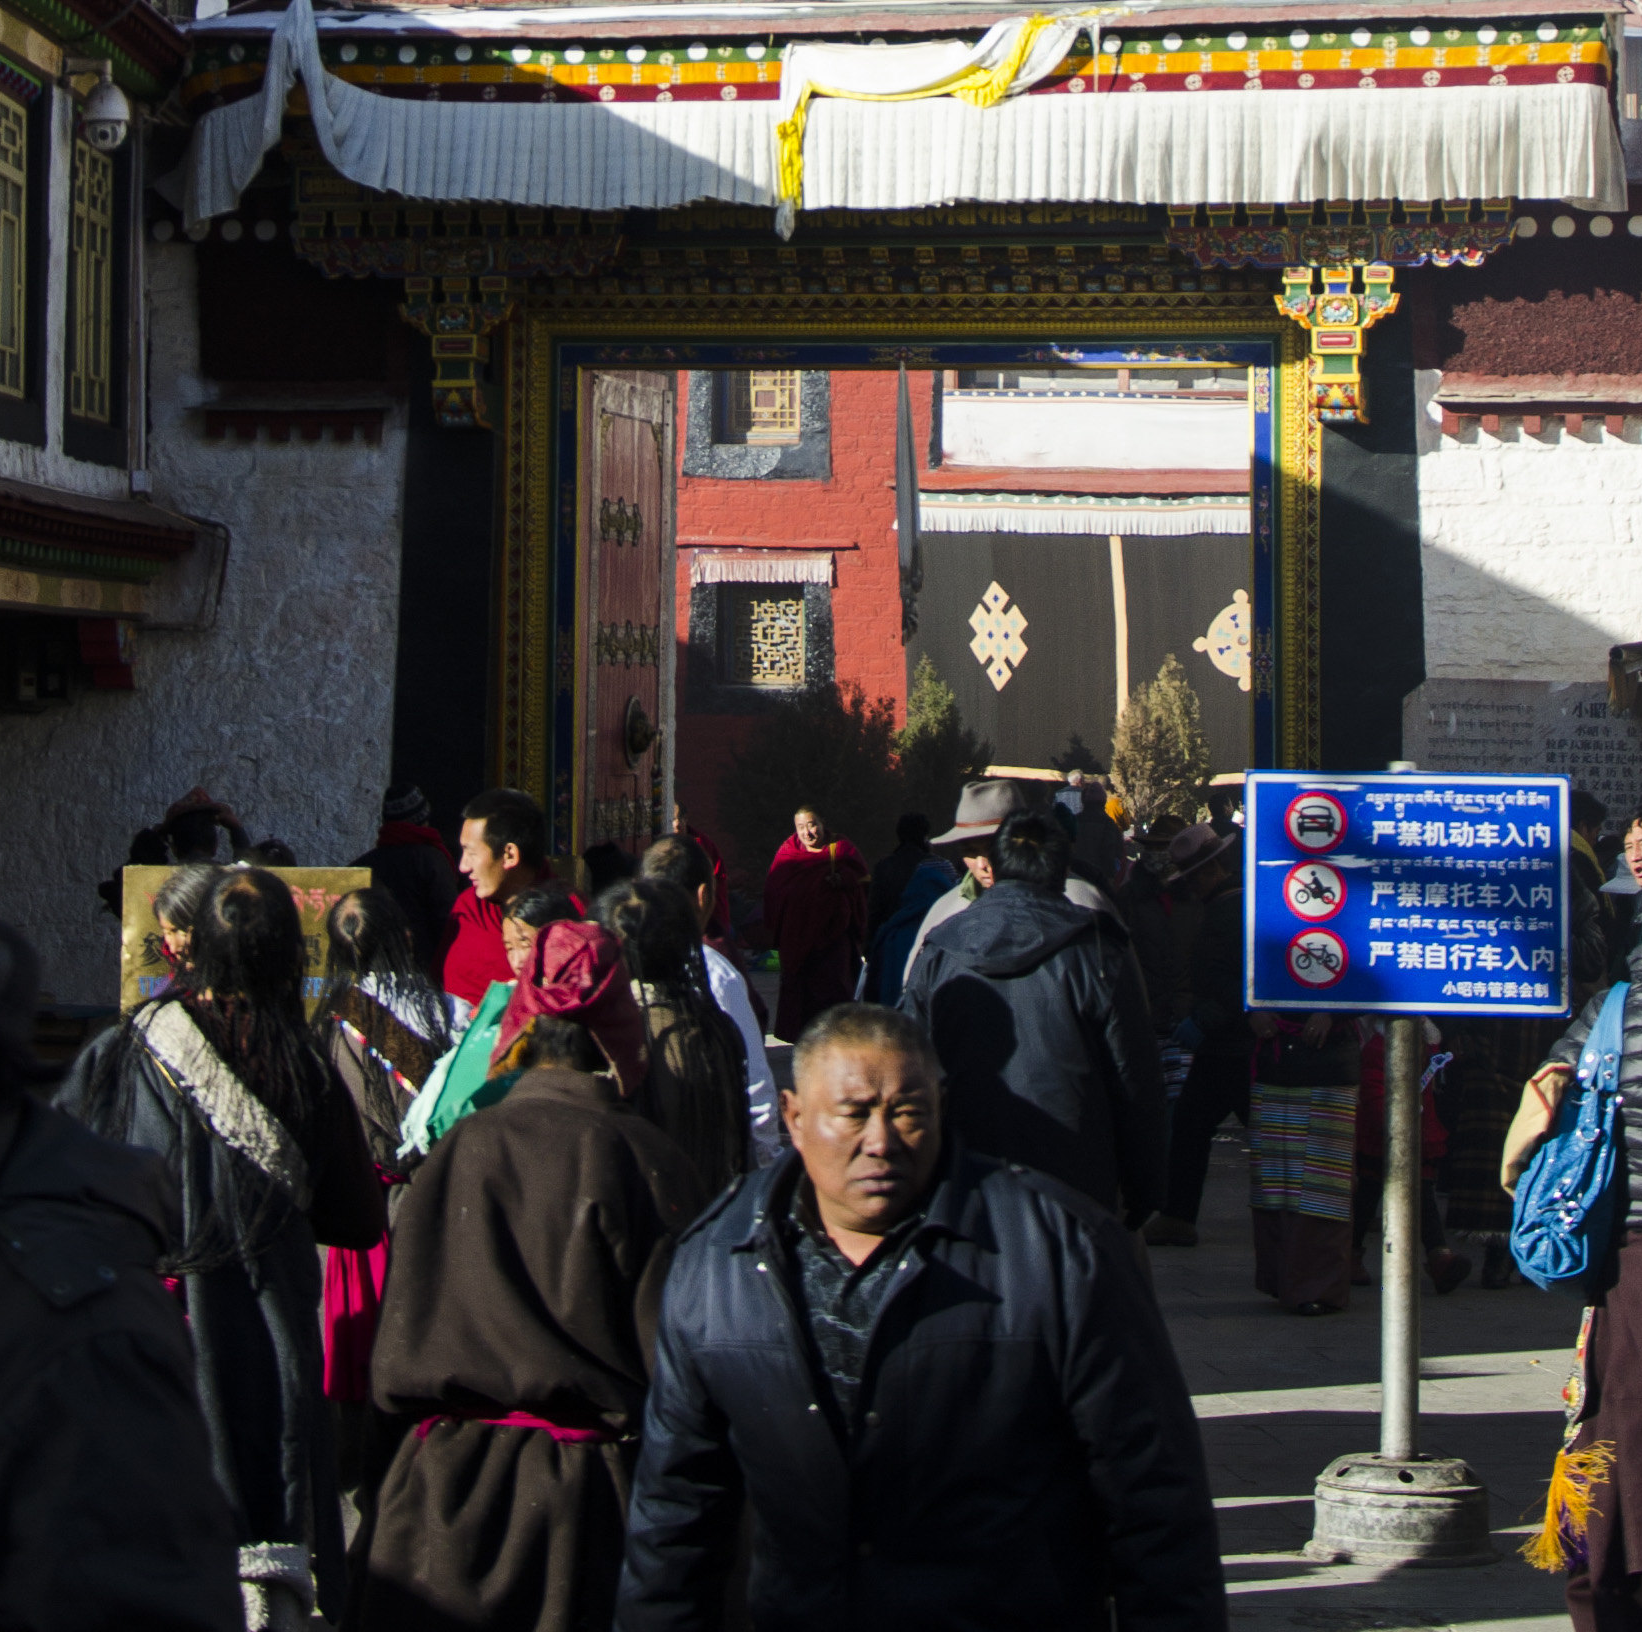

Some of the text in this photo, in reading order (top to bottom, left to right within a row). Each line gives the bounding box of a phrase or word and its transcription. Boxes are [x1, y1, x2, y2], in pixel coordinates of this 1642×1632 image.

[1371, 820, 1552, 848] 严禁机动车入内
[1370, 881, 1553, 909] 严禁摩托车入内
[1369, 941, 1555, 972] 严禁自行车入内
[1441, 980, 1550, 999] 小昭寺管委会制
